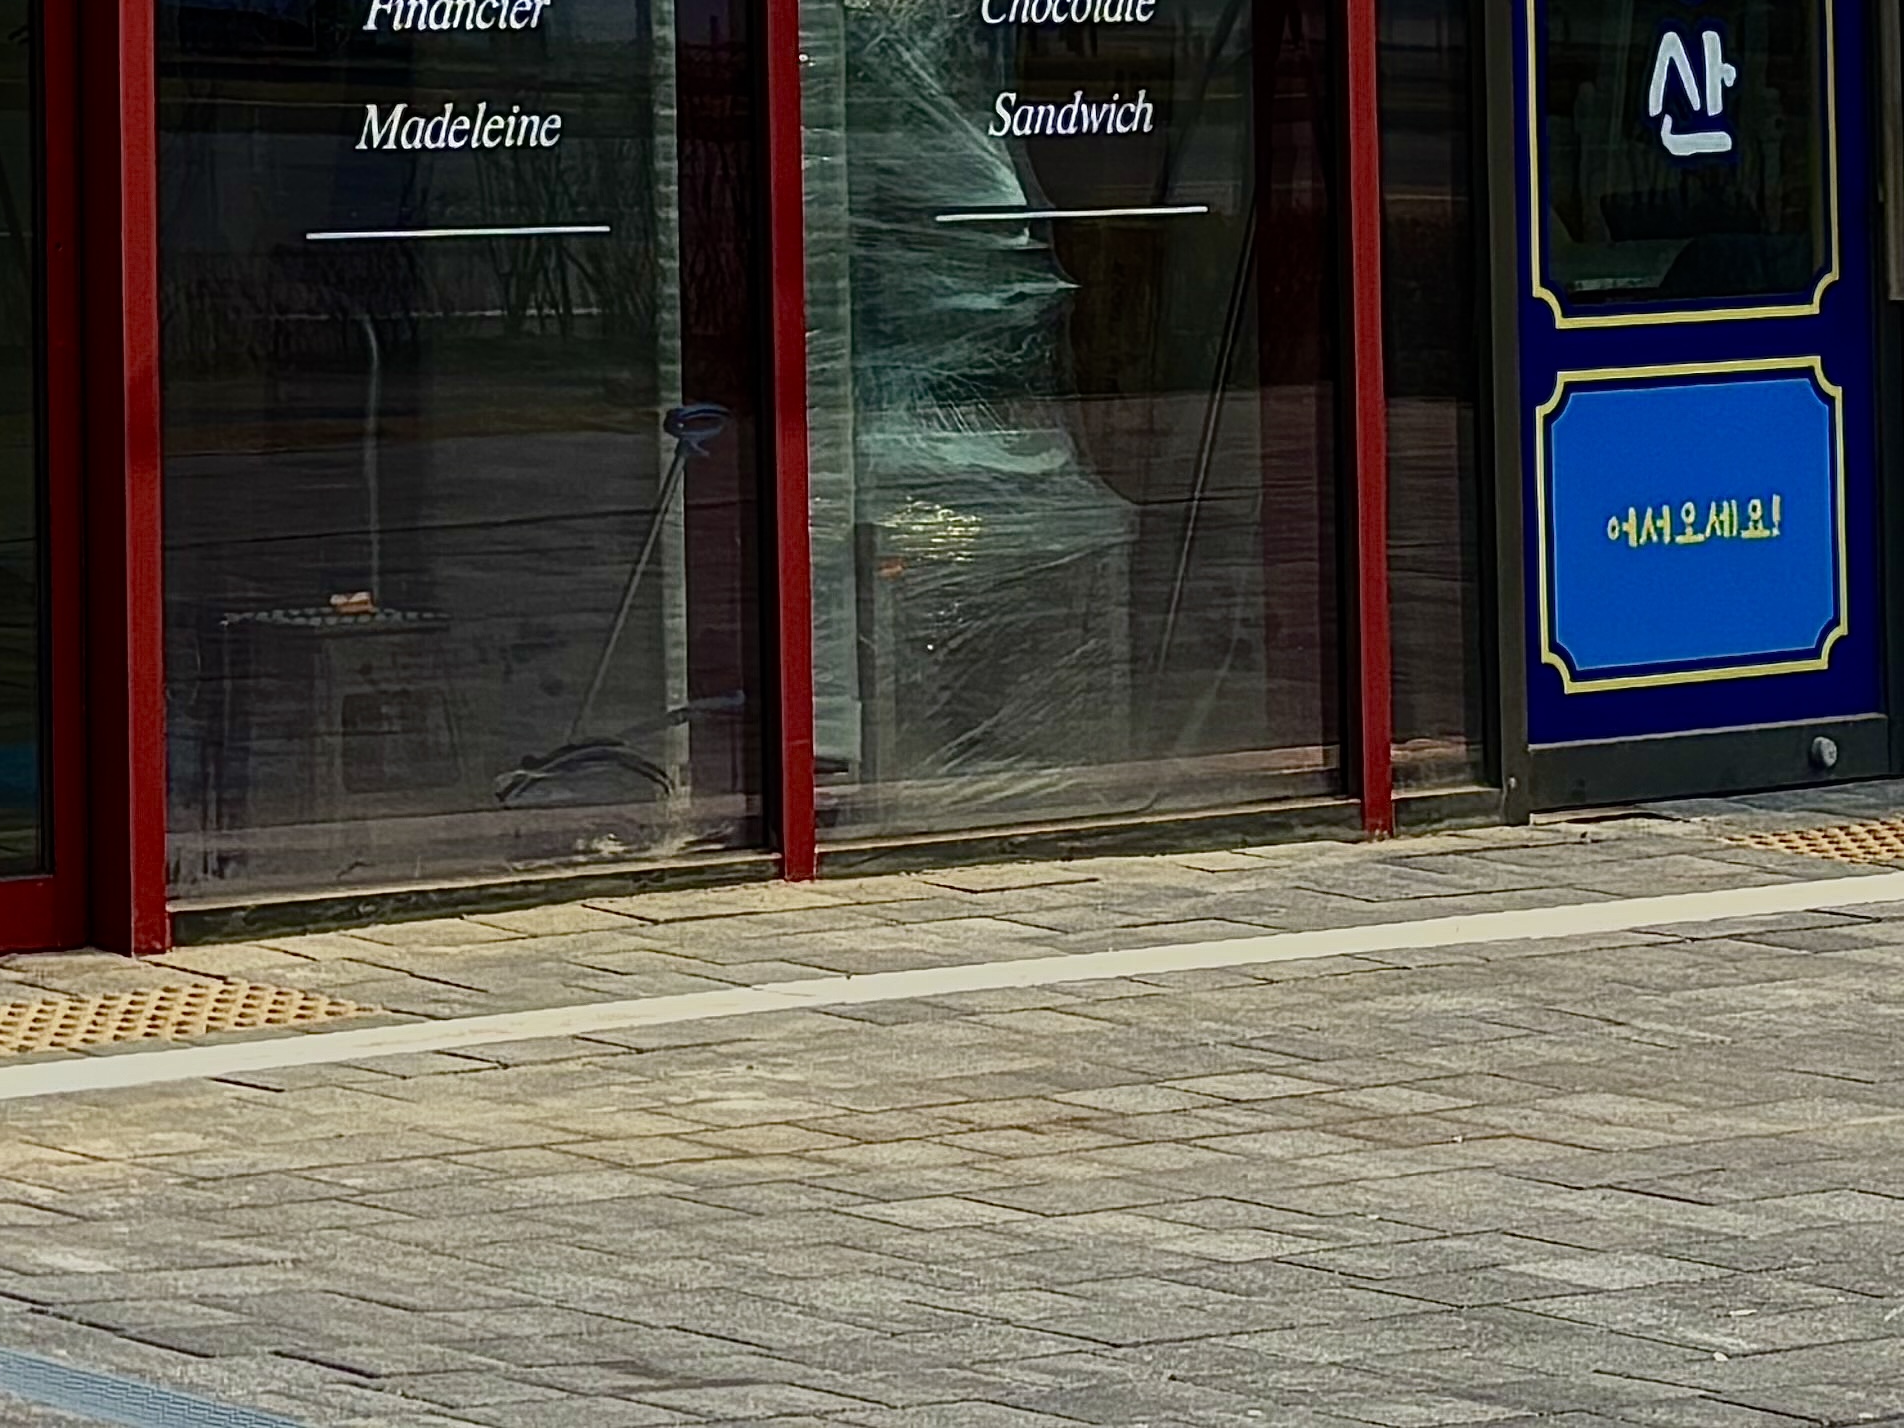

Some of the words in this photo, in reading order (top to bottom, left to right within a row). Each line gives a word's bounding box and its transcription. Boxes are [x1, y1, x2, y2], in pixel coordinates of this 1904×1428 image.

[355, 101, 562, 150] Madeleine
[988, 89, 1154, 137] Sandwich
[1607, 494, 1781, 548] 어서오세요!
